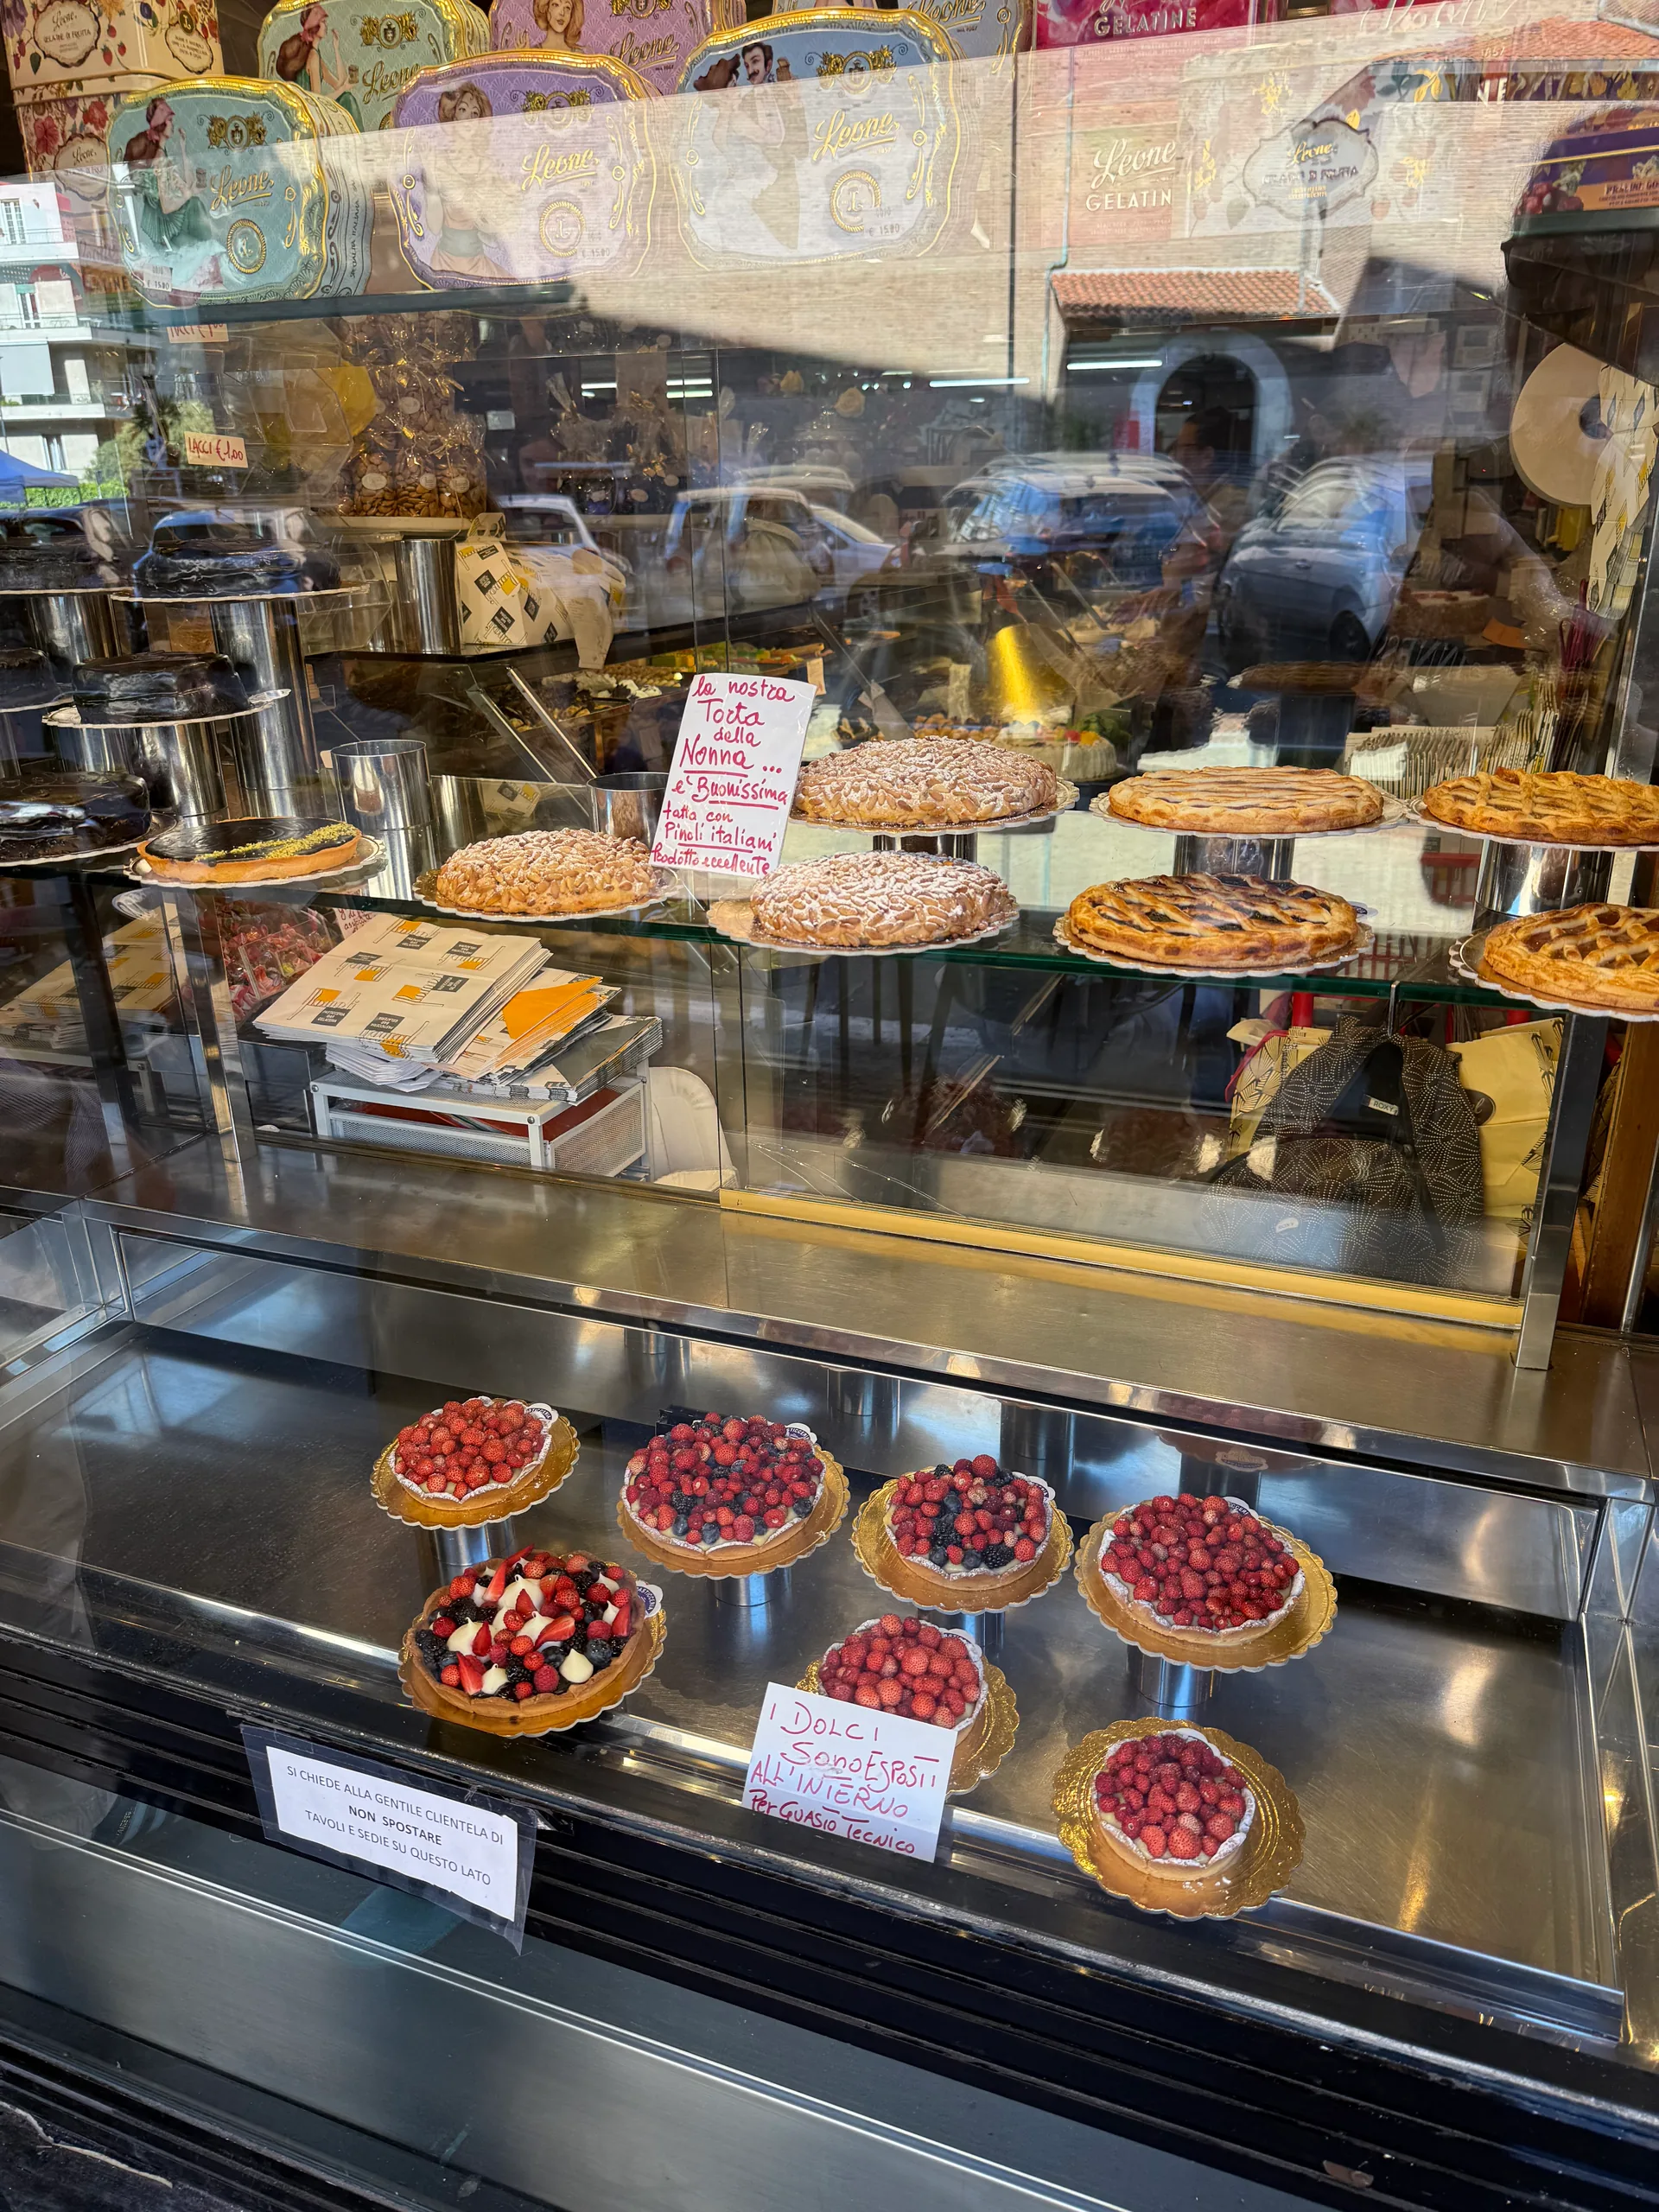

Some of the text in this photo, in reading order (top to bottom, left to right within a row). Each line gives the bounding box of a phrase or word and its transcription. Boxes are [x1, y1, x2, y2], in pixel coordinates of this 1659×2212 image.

[1094, 7, 1197, 36] GELATINE
[811, 110, 900, 162] Leone
[521, 143, 600, 191] Leone
[1090, 138, 1176, 189] Leone
[209, 164, 274, 211] Leone
[188, 436, 213, 458] LACCI
[691, 676, 796, 702] la nostra
[697, 699, 765, 727] Torta
[679, 734, 754, 769] Nonna
[713, 727, 761, 747] della
[691, 777, 788, 805] Buonissima
[665, 822, 703, 841] Pinoli
[705, 811, 734, 823] con
[1373, 1100, 1395, 1114] ROXY
[770, 1701, 878, 1741] I DOLCI
[287, 1765, 504, 1845] SI CHIEDE ALLA GENTILE CLIENTELA DI
[348, 1805, 442, 1846] NON SPOSTARE
[305, 1809, 491, 1885] TAVOLI E SEDIE SU QUESTO LATO
